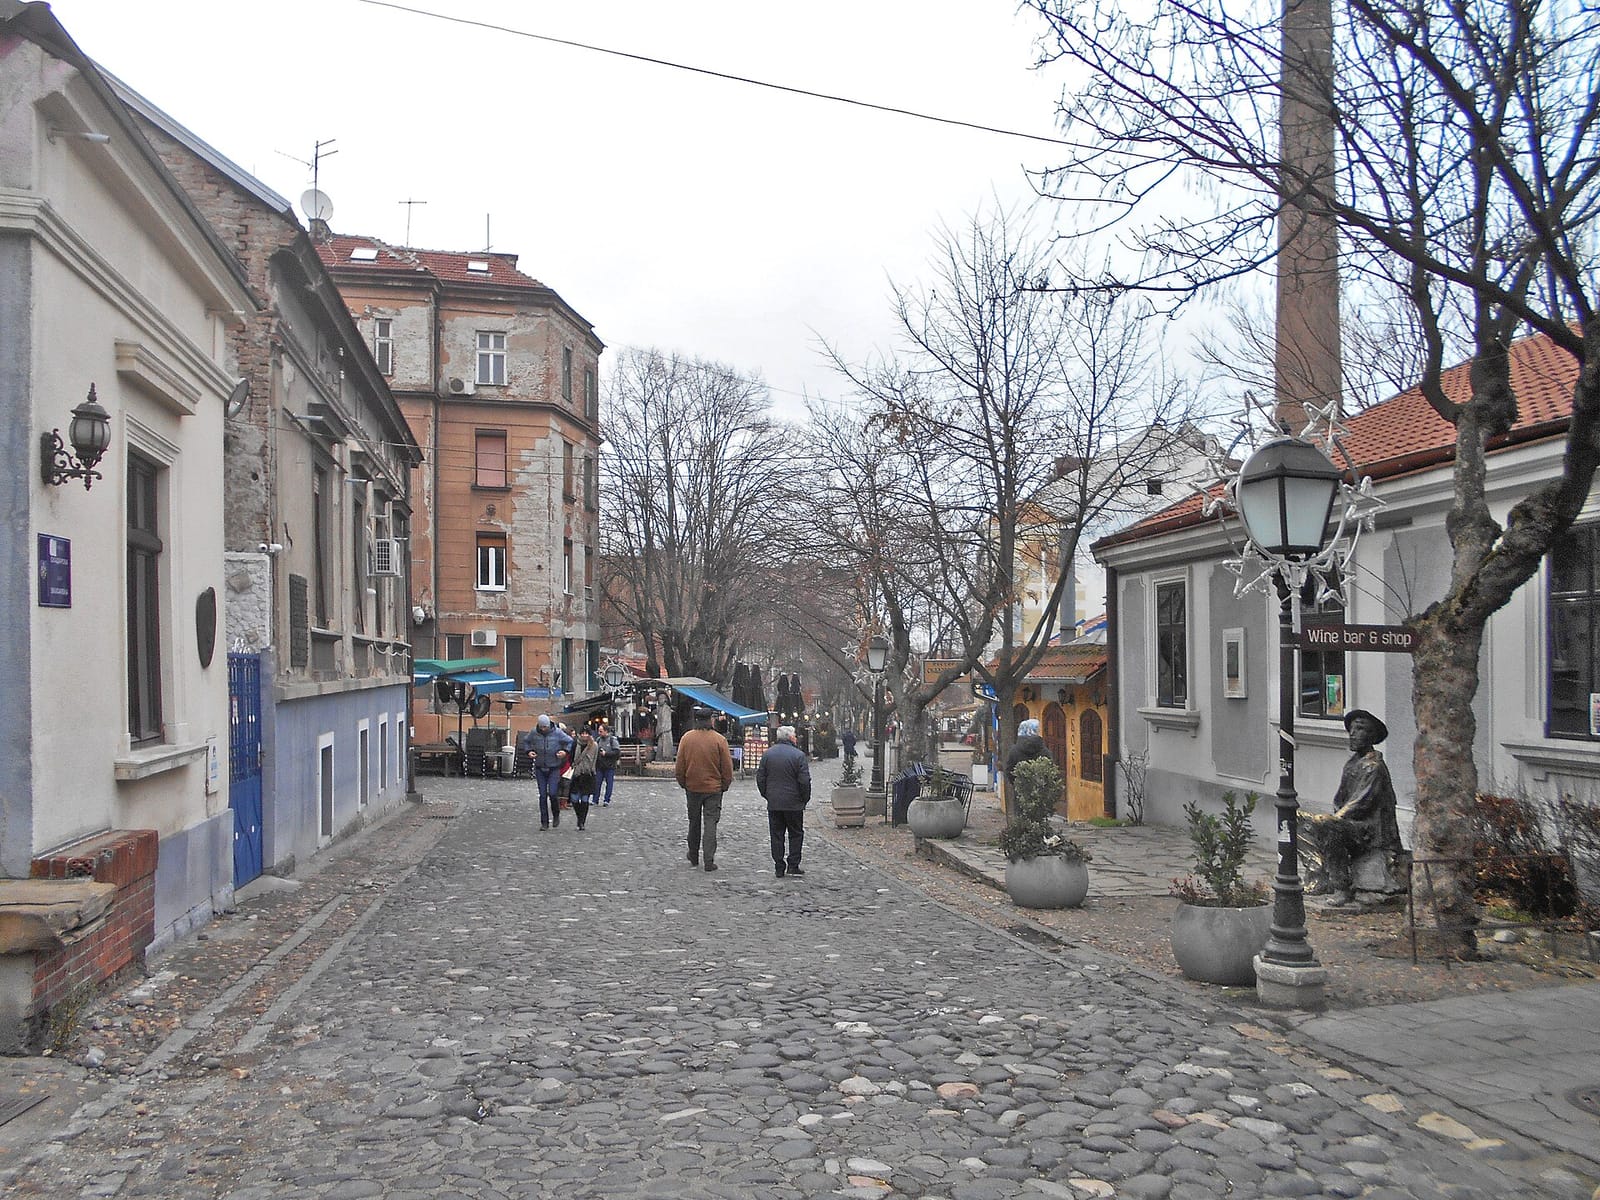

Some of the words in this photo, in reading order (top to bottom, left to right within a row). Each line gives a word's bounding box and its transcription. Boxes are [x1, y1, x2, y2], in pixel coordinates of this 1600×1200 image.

[1307, 629, 1339, 643] Wine
[1343, 630, 1366, 644] bar
[1369, 631, 1378, 644] &
[1382, 631, 1412, 648] shop
